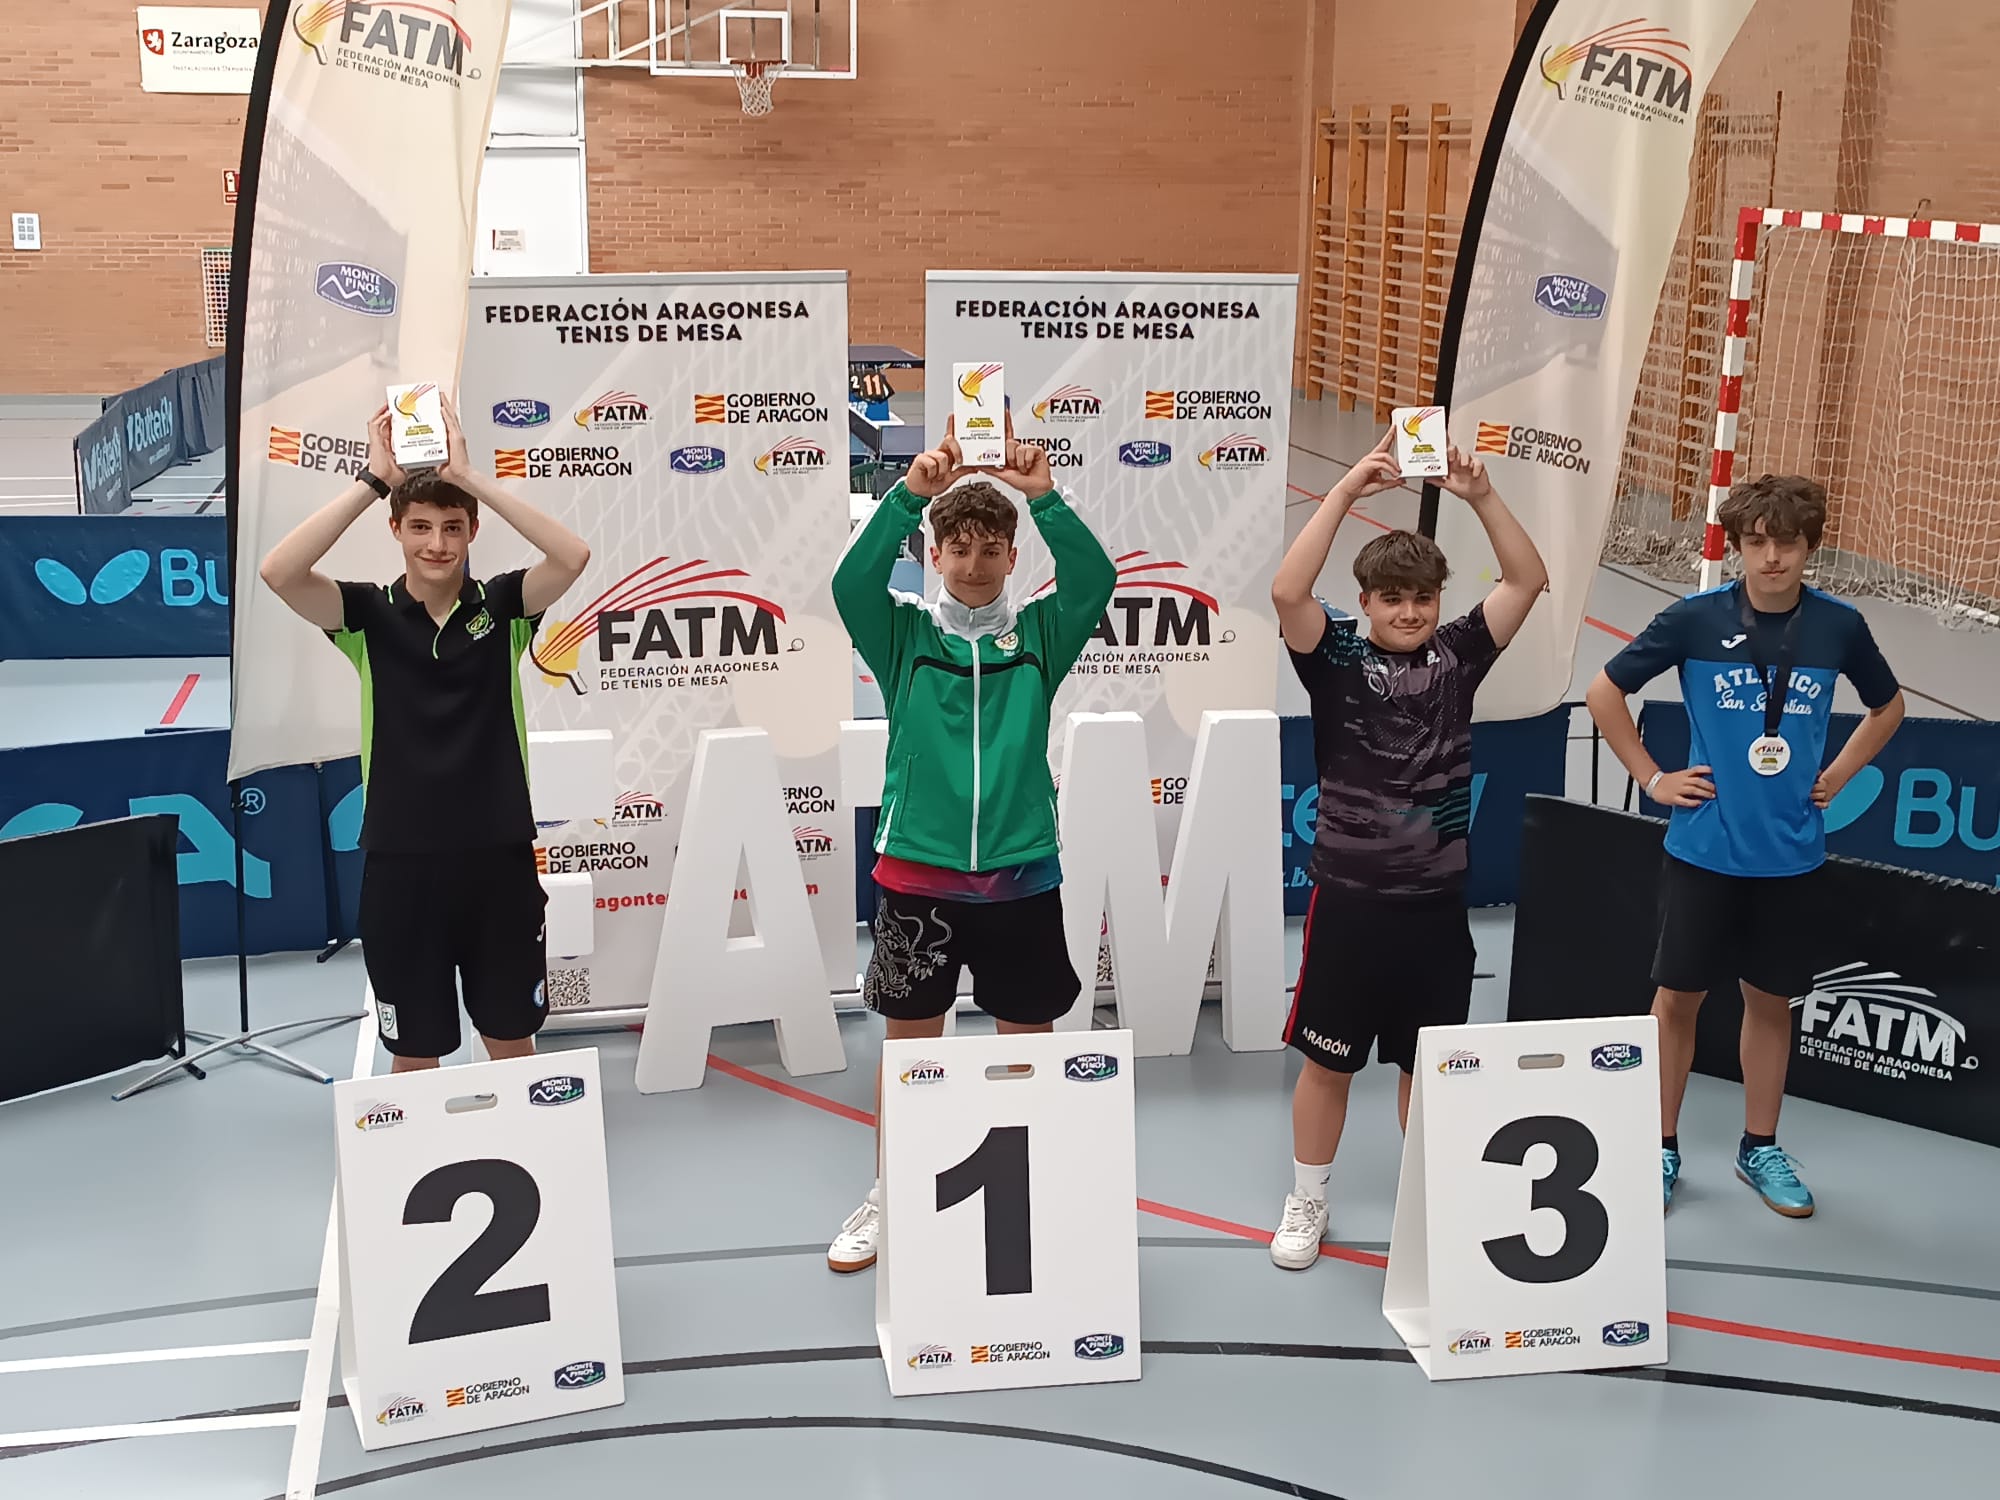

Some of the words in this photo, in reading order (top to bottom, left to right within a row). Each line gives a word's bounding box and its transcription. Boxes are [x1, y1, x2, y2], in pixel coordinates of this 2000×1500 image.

[171, 31, 258, 54] Zaragoza
[340, 0, 464, 76] FATM
[337, 47, 401, 71] FEDERACIÓN
[336, 58, 349, 68] DE
[352, 62, 381, 76] TENIS
[384, 69, 397, 80] DE
[400, 74, 429, 89] MESA
[1580, 43, 1692, 114] FATM
[1574, 94, 1587, 104] DE
[1589, 97, 1615, 111] TENIS
[1617, 104, 1628, 115] DE
[1630, 109, 1652, 122] MESA
[340, 265, 381, 285] MONTE
[345, 277, 380, 295] PINOS
[1552, 276, 1590, 293] MONTE
[1554, 286, 1587, 303] PINOS
[485, 297, 648, 324] FEDERACIÓN
[656, 300, 810, 321] ARAGONESA
[955, 295, 1107, 319] FEDERACIÓN
[1115, 301, 1260, 320] ARAGONESA
[556, 324, 629, 344] TENIS
[639, 324, 668, 342] DE
[677, 323, 743, 342] MESA
[1020, 321, 1088, 340] TENIS
[1097, 321, 1125, 340] DE
[1133, 322, 1195, 340] MESA
[863, 374, 882, 396] 11
[727, 392, 816, 408] GOBIERNO
[1176, 390, 1261, 405] GOBIERNO
[593, 405, 647, 422] FATM
[1049, 398, 1100, 415] FATM
[1176, 406, 1198, 420] DE
[1203, 405, 1272, 420] ARAGON
[728, 409, 752, 424] DE
[756, 407, 828, 424] ARAGON
[1510, 425, 1582, 453] GOBIERNO
[301, 451, 327, 471] DE
[528, 446, 619, 462] GOBIERNO
[773, 450, 824, 466] FATM
[1216, 446, 1265, 462] FATM
[1507, 442, 1532, 460] DE
[1536, 447, 1591, 475] ARAGON
[529, 463, 555, 478] DE
[559, 462, 632, 478] ARAGON
[598, 605, 779, 662] FATM
[1128, 652, 1210, 663] ARAGONESA
[600, 664, 689, 678] FEDERACIÓN
[694, 661, 780, 673] ARAGONESA
[1103, 664, 1120, 675] DE
[1125, 664, 1161, 675] MESA
[601, 680, 619, 690] DE
[623, 678, 662, 690] TENIS
[667, 677, 686, 687] DE
[690, 675, 728, 686] MESA
[1713, 667, 1822, 699] ATLICO
[1716, 689, 1746, 711] San
[1163, 792, 1184, 804] DE
[612, 803, 663, 820] FATM
[549, 842, 636, 859] GOBIERNO
[549, 860, 572, 873] DE
[577, 855, 649, 872] ARAGON
[1800, 989, 1956, 1067] FATM
[1302, 1026, 1351, 1057] ARAGÓN
[1448, 1058, 1480, 1069] FATM
[1799, 1045, 1815, 1057] DE
[1818, 1048, 1851, 1066] TENIS
[1854, 1059, 1870, 1071] DE
[1873, 1064, 1907, 1080] MESA
[1877, 1054, 1953, 1081] ARAGONESA
[911, 1069, 945, 1080] FATM
[367, 1110, 404, 1125] FATM
[1481, 1115, 1610, 1284] 3
[935, 1125, 1032, 1296] 1
[402, 1158, 551, 1345] 2
[1522, 1327, 1573, 1338] GOBIERNO
[990, 1341, 1042, 1352] GOBIERNO
[1459, 1338, 1490, 1349] FATM
[1523, 1339, 1536, 1348] DE
[919, 1353, 952, 1364] FATM
[990, 1353, 1004, 1362] DE
[465, 1377, 521, 1395] GOBIERNO
[466, 1395, 481, 1405] DE
[388, 1403, 424, 1420] FATM
